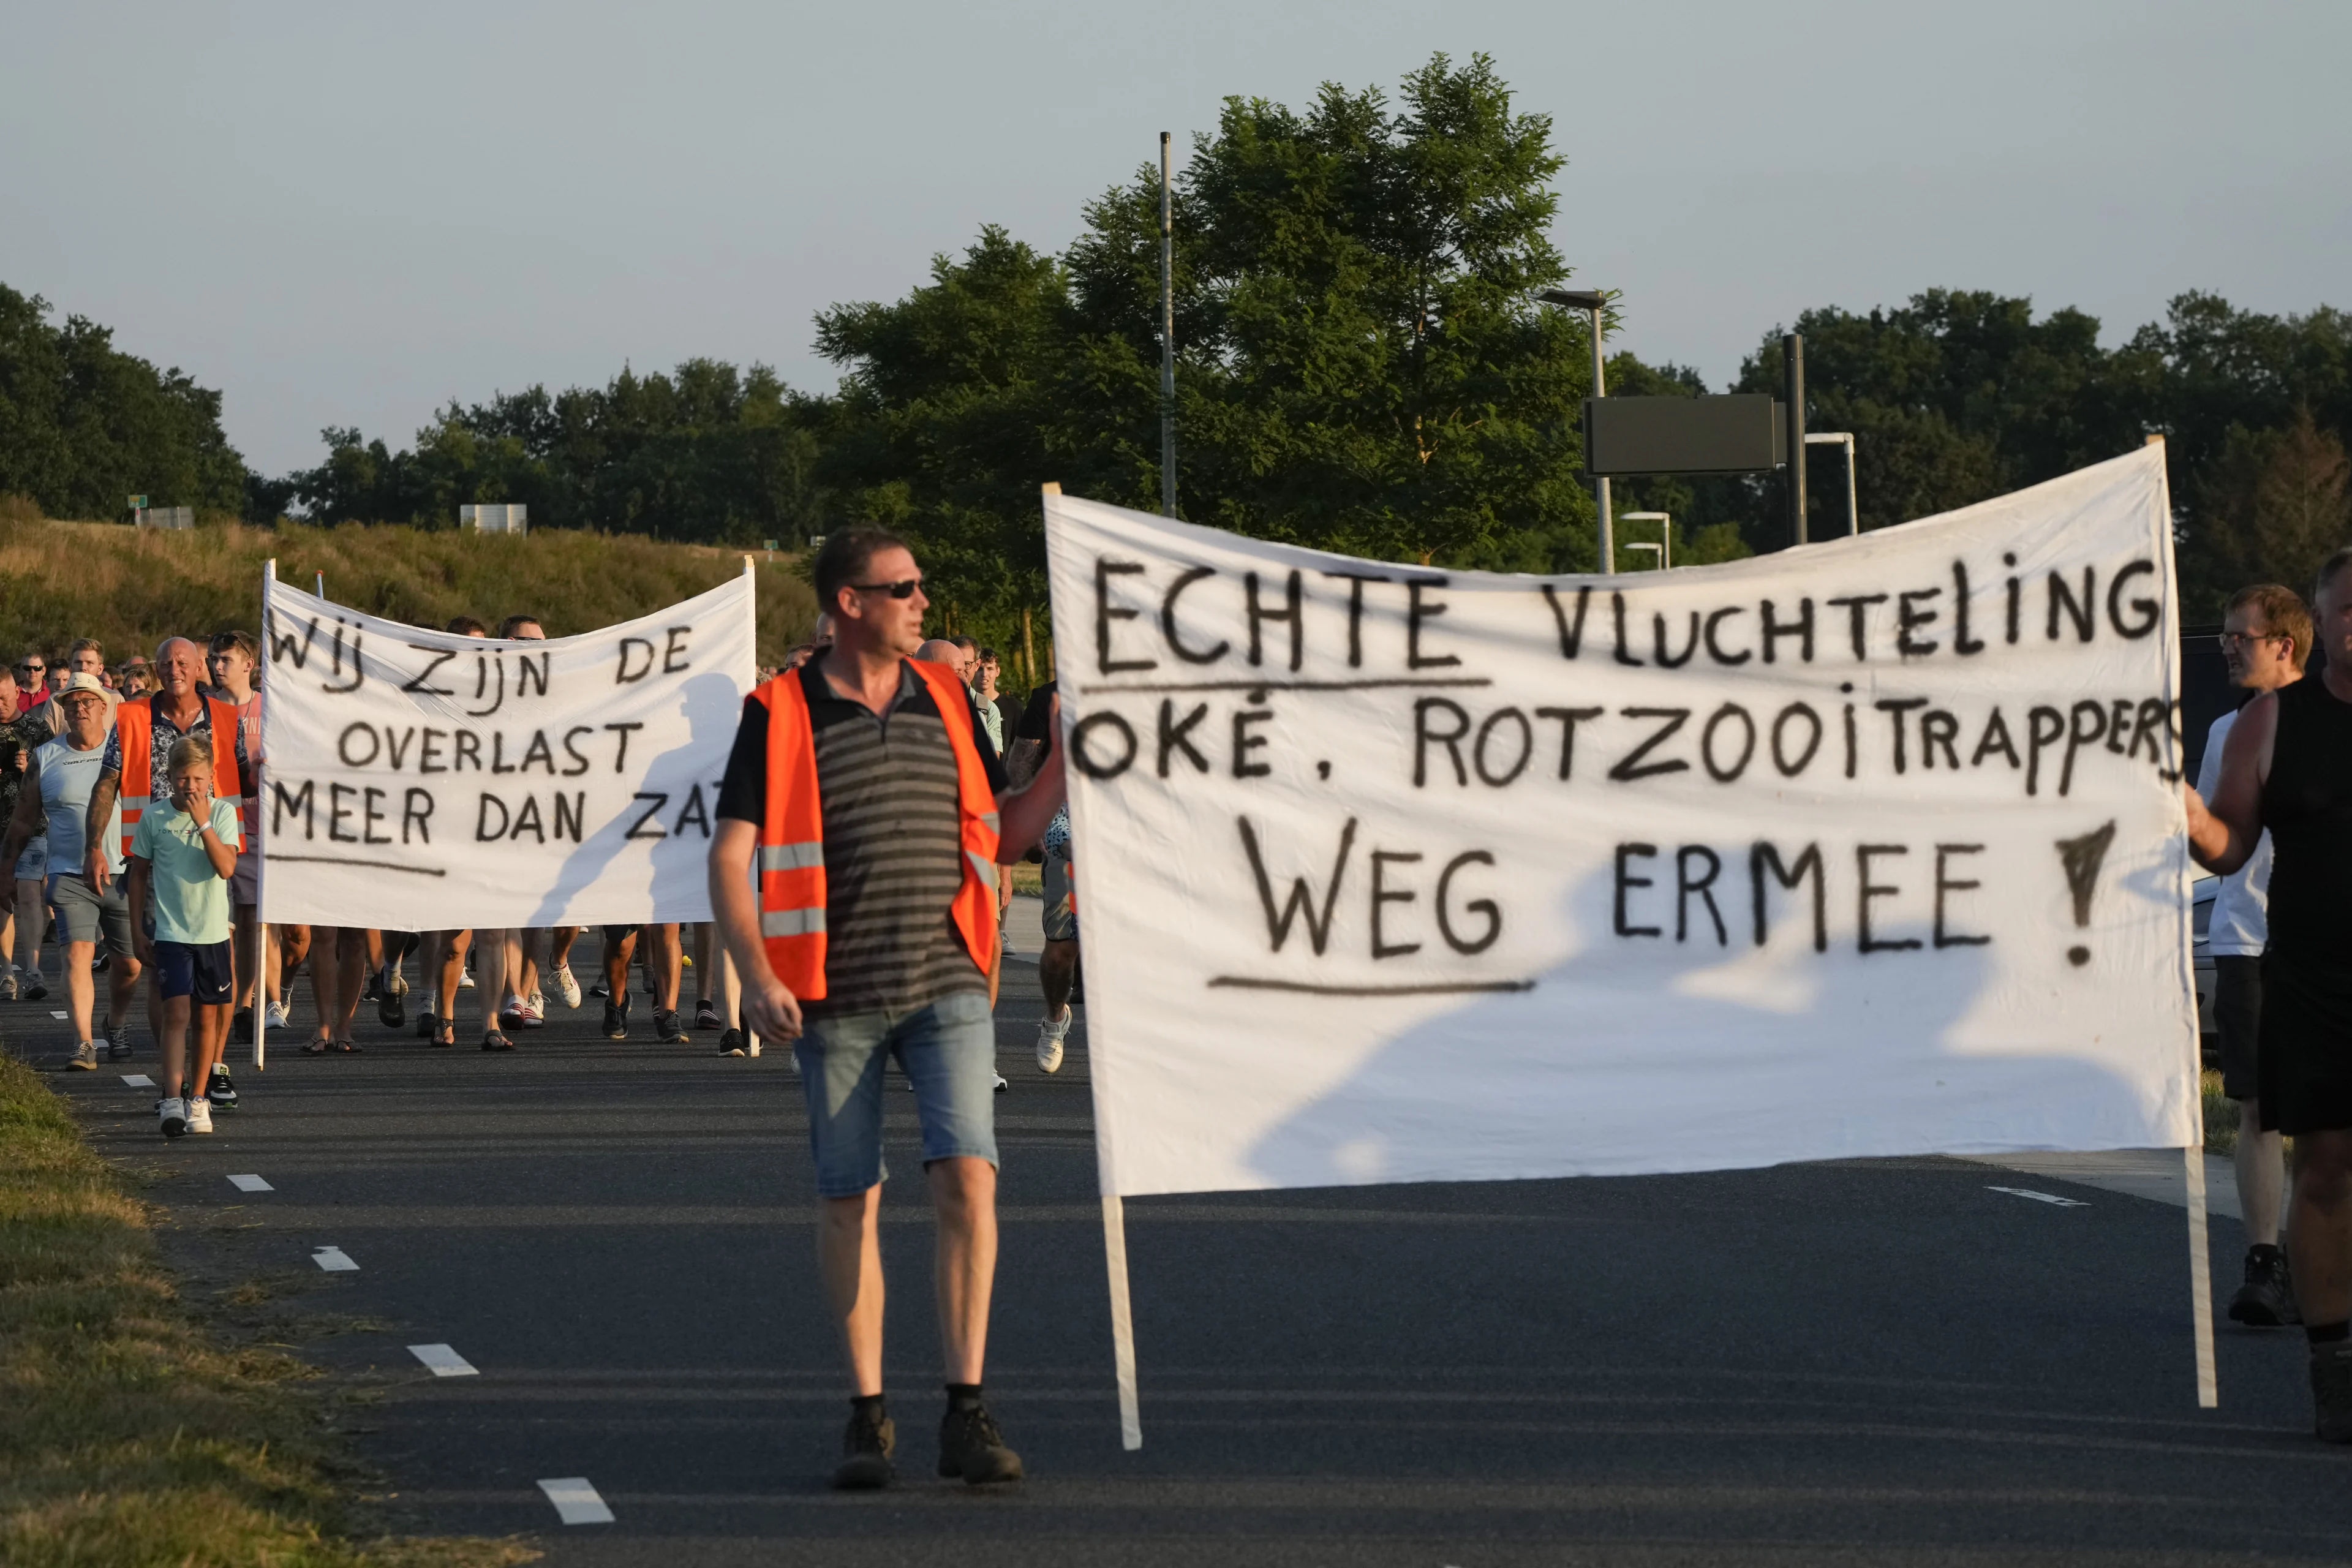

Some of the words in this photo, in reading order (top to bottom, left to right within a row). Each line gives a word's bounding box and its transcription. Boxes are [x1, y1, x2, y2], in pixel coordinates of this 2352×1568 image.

[1094, 556, 1462, 676] ECHTE
[615, 625, 692, 685] DE
[337, 721, 644, 777] OVERLAST
[271, 778, 435, 845] MEER
[475, 791, 586, 845] DAN
[624, 781, 723, 841] ZA
[1237, 815, 1504, 960] WEG
[1612, 841, 1992, 957] ERMEE
